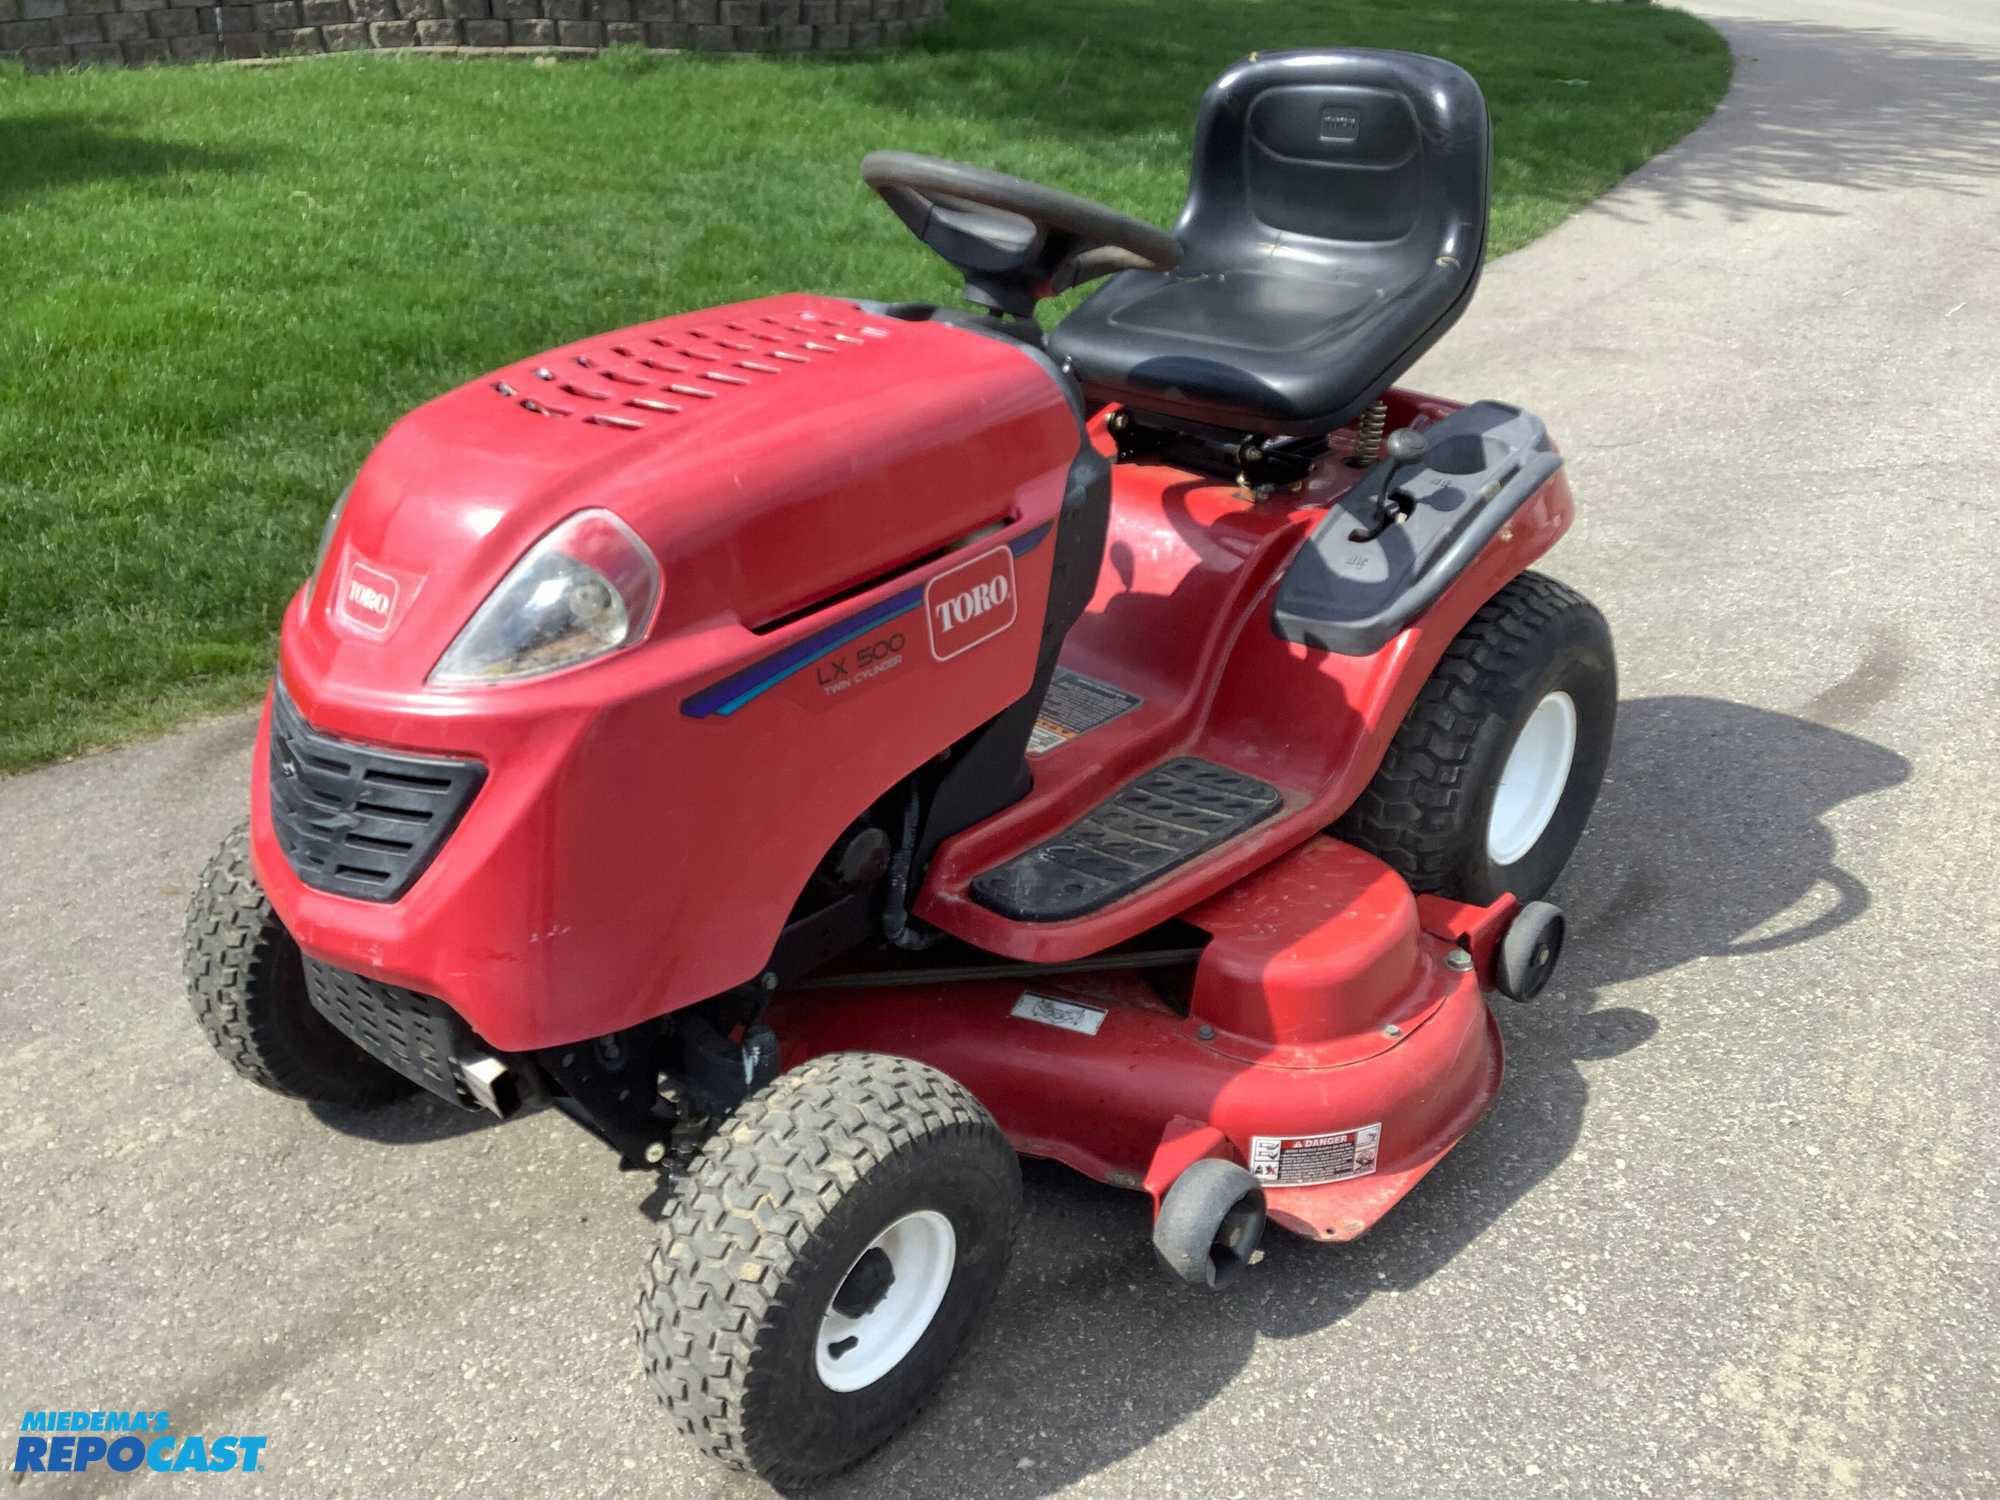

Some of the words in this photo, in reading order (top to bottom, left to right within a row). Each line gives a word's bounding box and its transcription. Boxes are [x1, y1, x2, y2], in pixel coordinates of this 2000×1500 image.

[936, 574, 1009, 633] TORO
[815, 658, 849, 686] LX
[856, 632, 906, 669] 500
[823, 678, 851, 696] TWIN
[854, 654, 903, 685] CYLINDER
[1304, 1134, 1348, 1148] DANGER
